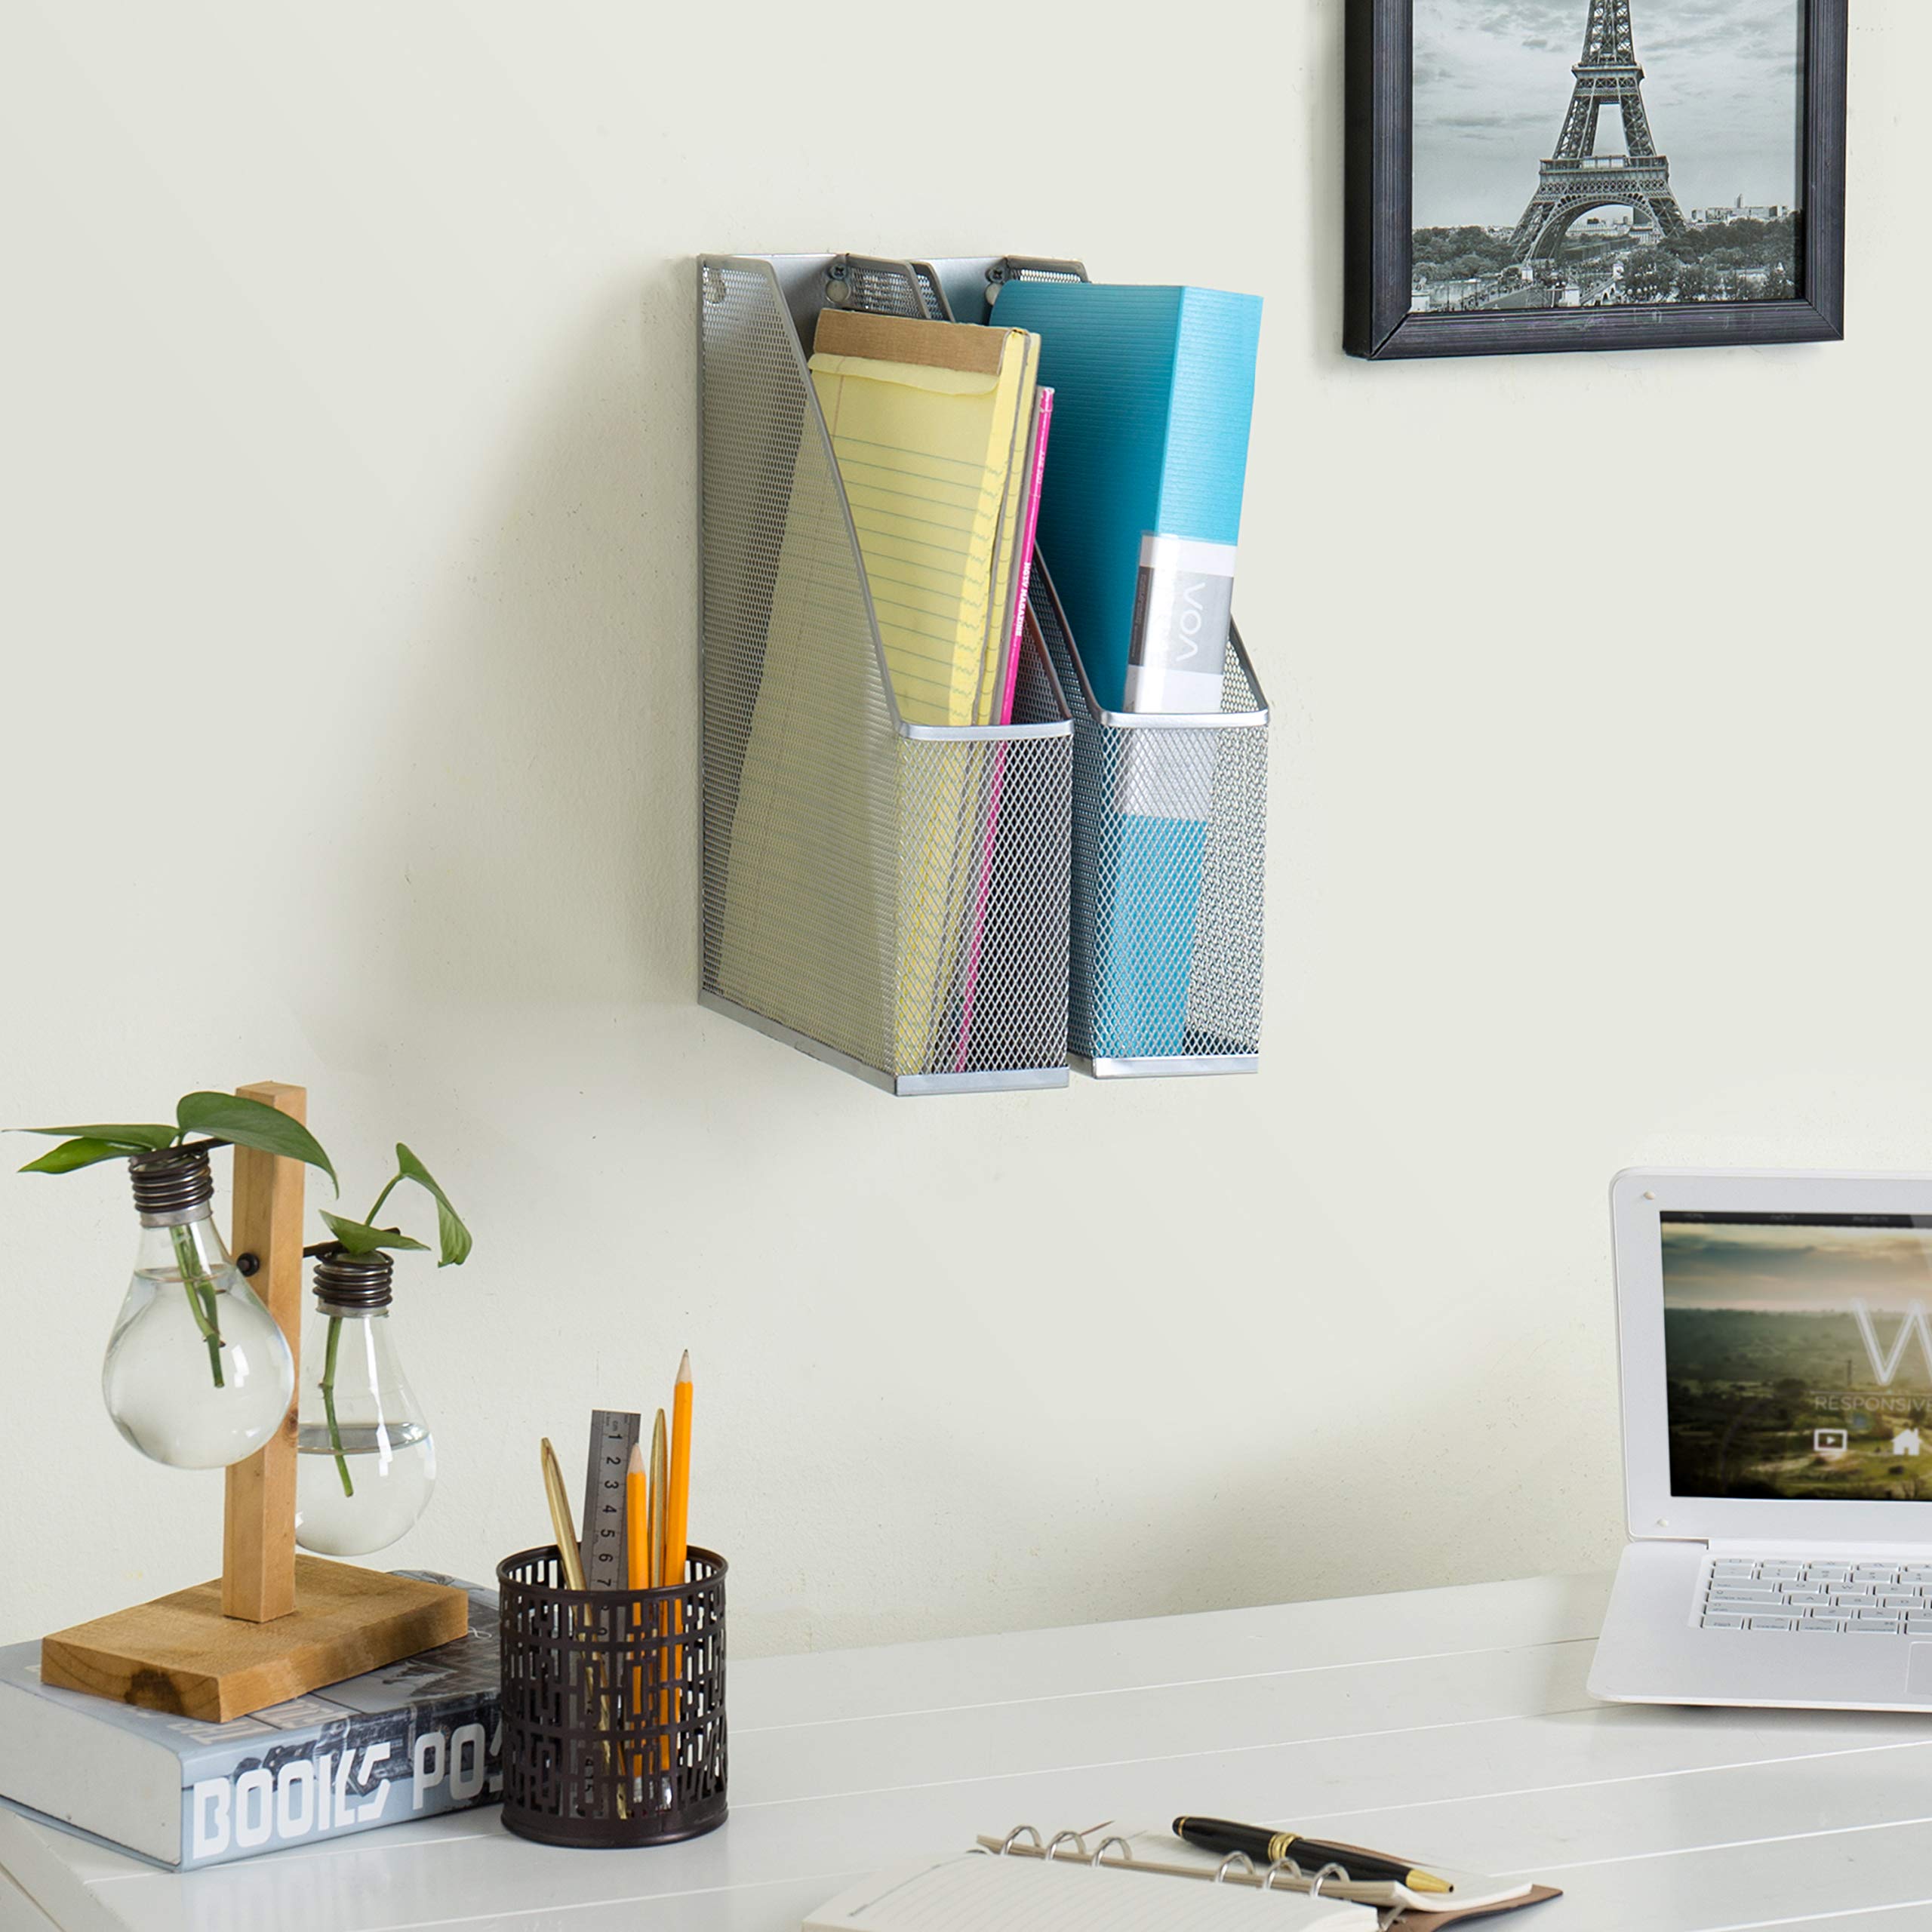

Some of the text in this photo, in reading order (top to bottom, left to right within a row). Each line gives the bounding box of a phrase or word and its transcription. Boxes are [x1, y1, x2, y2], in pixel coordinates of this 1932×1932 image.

[1015, 589, 1028, 637] MAGAZINE
[606, 1457, 621, 1466] 2
[605, 1480, 619, 1489] 3
[602, 1505, 617, 1513] 4
[601, 1529, 615, 1538] 5
[598, 1553, 613, 1562] 6
[597, 1578, 612, 1587] 7
[193, 1742, 391, 1860] BOOKS
